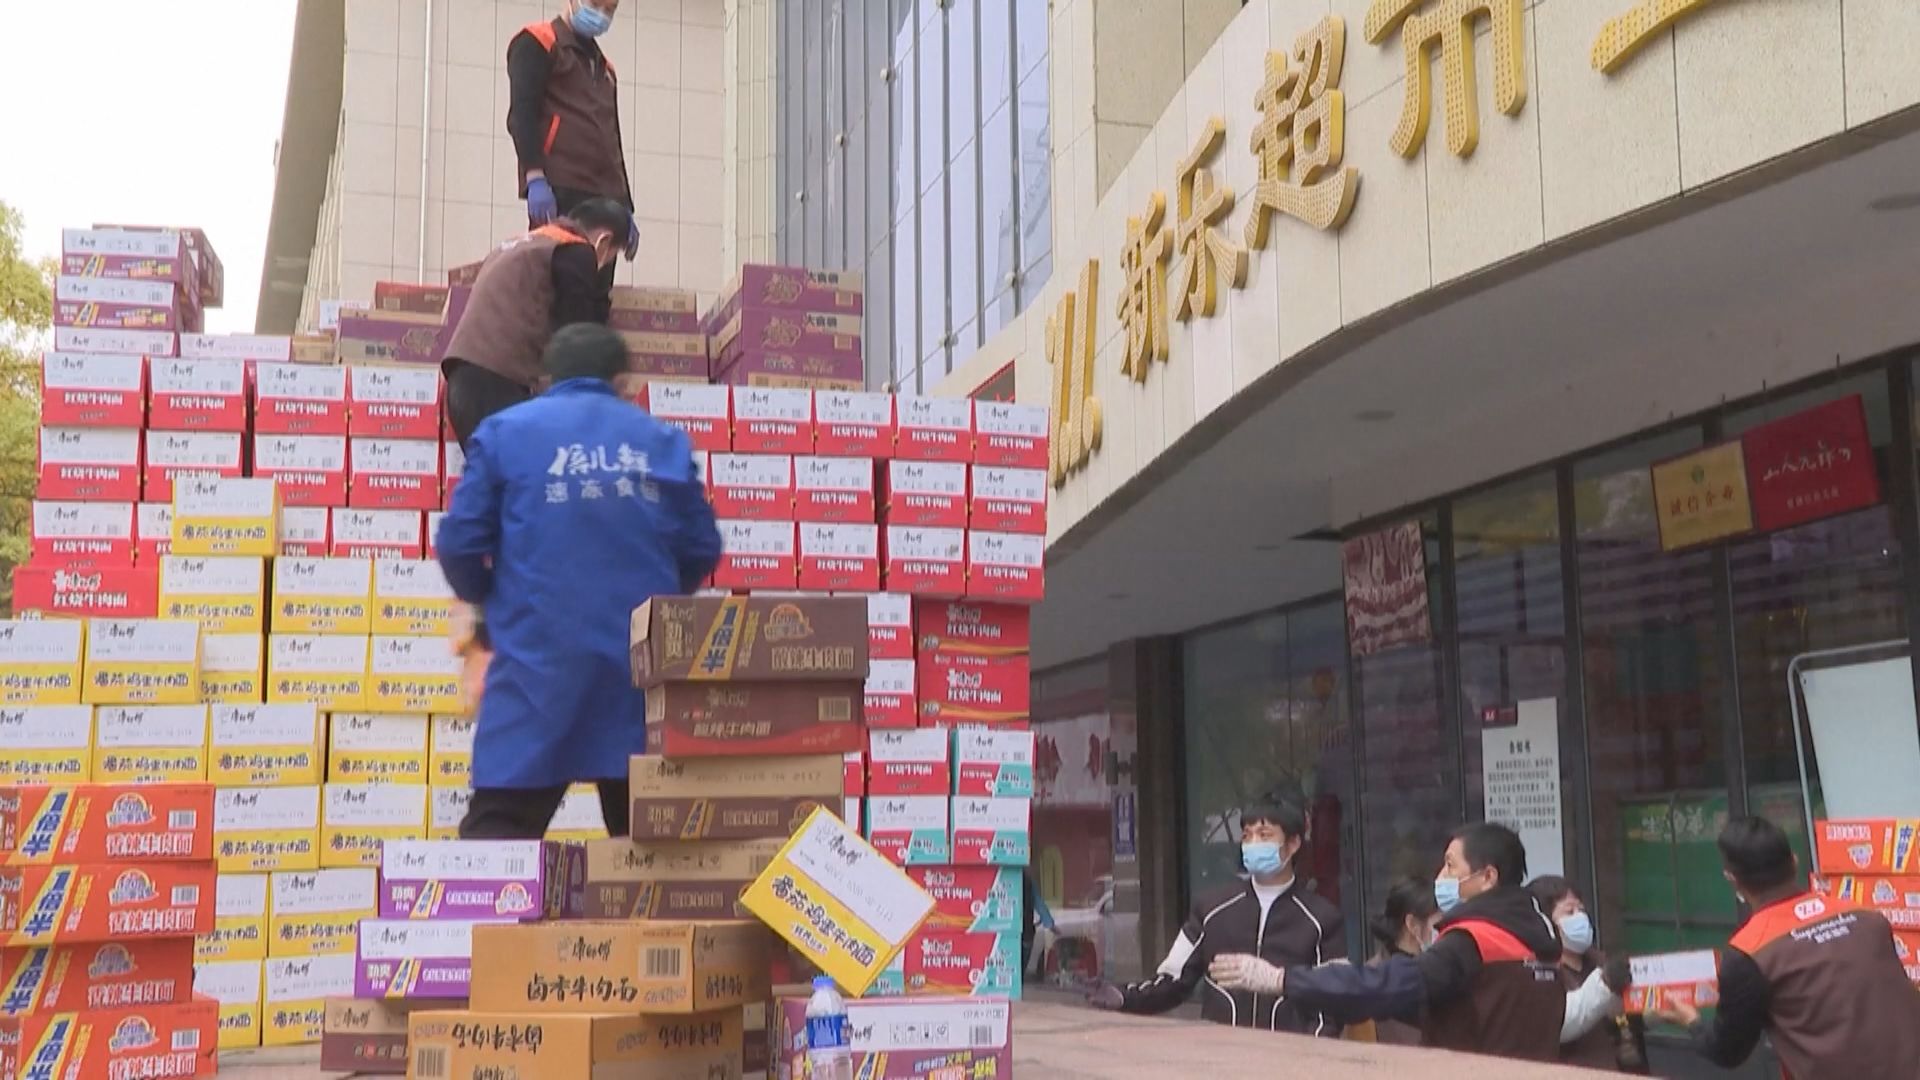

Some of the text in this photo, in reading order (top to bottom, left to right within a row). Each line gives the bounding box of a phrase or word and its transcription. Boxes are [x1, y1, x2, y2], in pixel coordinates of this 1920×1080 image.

[64, 391, 123, 405] 红烧牛肉面
[169, 397, 226, 409] 红烧牛肉面
[274, 402, 328, 415] 红烧牛肉面
[367, 404, 420, 417] 红烧牛肉面
[750, 423, 796, 435] 红烧牛肉面
[831, 426, 878, 438] 红烧牛肉面
[911, 432, 956, 444] 红烧牛肉面
[989, 437, 1034, 449] 红烧牛肉面
[60, 466, 119, 480] 红烧牛肉面
[272, 472, 326, 485] 红烧牛肉面
[367, 475, 420, 489] 红烧牛肉面
[194, 482, 218, 497] 康师傅
[728, 489, 775, 501] 红烧牛肉面
[811, 493, 858, 505] 红烧牛肉面
[905, 496, 952, 508] 红烧牛肉面
[987, 503, 1032, 515] 红烧牛肉面
[52, 540, 112, 554] 红烧牛肉面
[181, 558, 205, 573] 康师傅
[293, 561, 316, 576] 康师傅
[391, 563, 414, 577] 康师傅
[731, 557, 779, 569] 红烧牛肉面
[816, 560, 863, 572] 红烧牛肉面
[903, 564, 949, 576] 红烧牛肉面
[983, 568, 1028, 580] 红烧牛肉面
[53, 593, 127, 607] 红烧牛肉面
[0, 624, 15, 638] 师傅
[109, 624, 136, 638] 康师傅
[869, 628, 897, 641] 牛肉面
[946, 624, 1001, 638] 红烧牛肉面
[292, 639, 313, 653] 康师傅
[699, 606, 738, 672] 1倍半
[389, 640, 413, 653] 康师傅
[0, 674, 72, 689] 鸡蛋牛肉面
[864, 696, 900, 708] 烧牛肉面
[946, 690, 1002, 704] 红烧牛肉面
[118, 710, 145, 725] 康师傅
[231, 710, 256, 725] 康师傅
[349, 717, 371, 729] 康师傅
[886, 764, 933, 776] 红烧牛肉面
[233, 790, 259, 805] 康师傅
[344, 791, 367, 804] 康师傅
[22, 791, 68, 859] 1倍半
[829, 833, 863, 866] 康师傅
[403, 850, 428, 867] 康师傅
[293, 876, 317, 890] 康师傅
[23, 866, 74, 938] 1倍半
[771, 874, 875, 968] 番茄鸡蛋牛肉面
[381, 928, 408, 944] 康师傅
[572, 937, 612, 961] 康师傅
[286, 961, 312, 977] 康师傅
[922, 956, 971, 968] 红烧牛肉面
[3, 946, 50, 1015] 1倍半
[527, 974, 638, 1003] 卤香牛肉面
[452, 1023, 543, 1055] 卤香牛肉面
[658, 1022, 723, 1049] 卤香牛肉面
